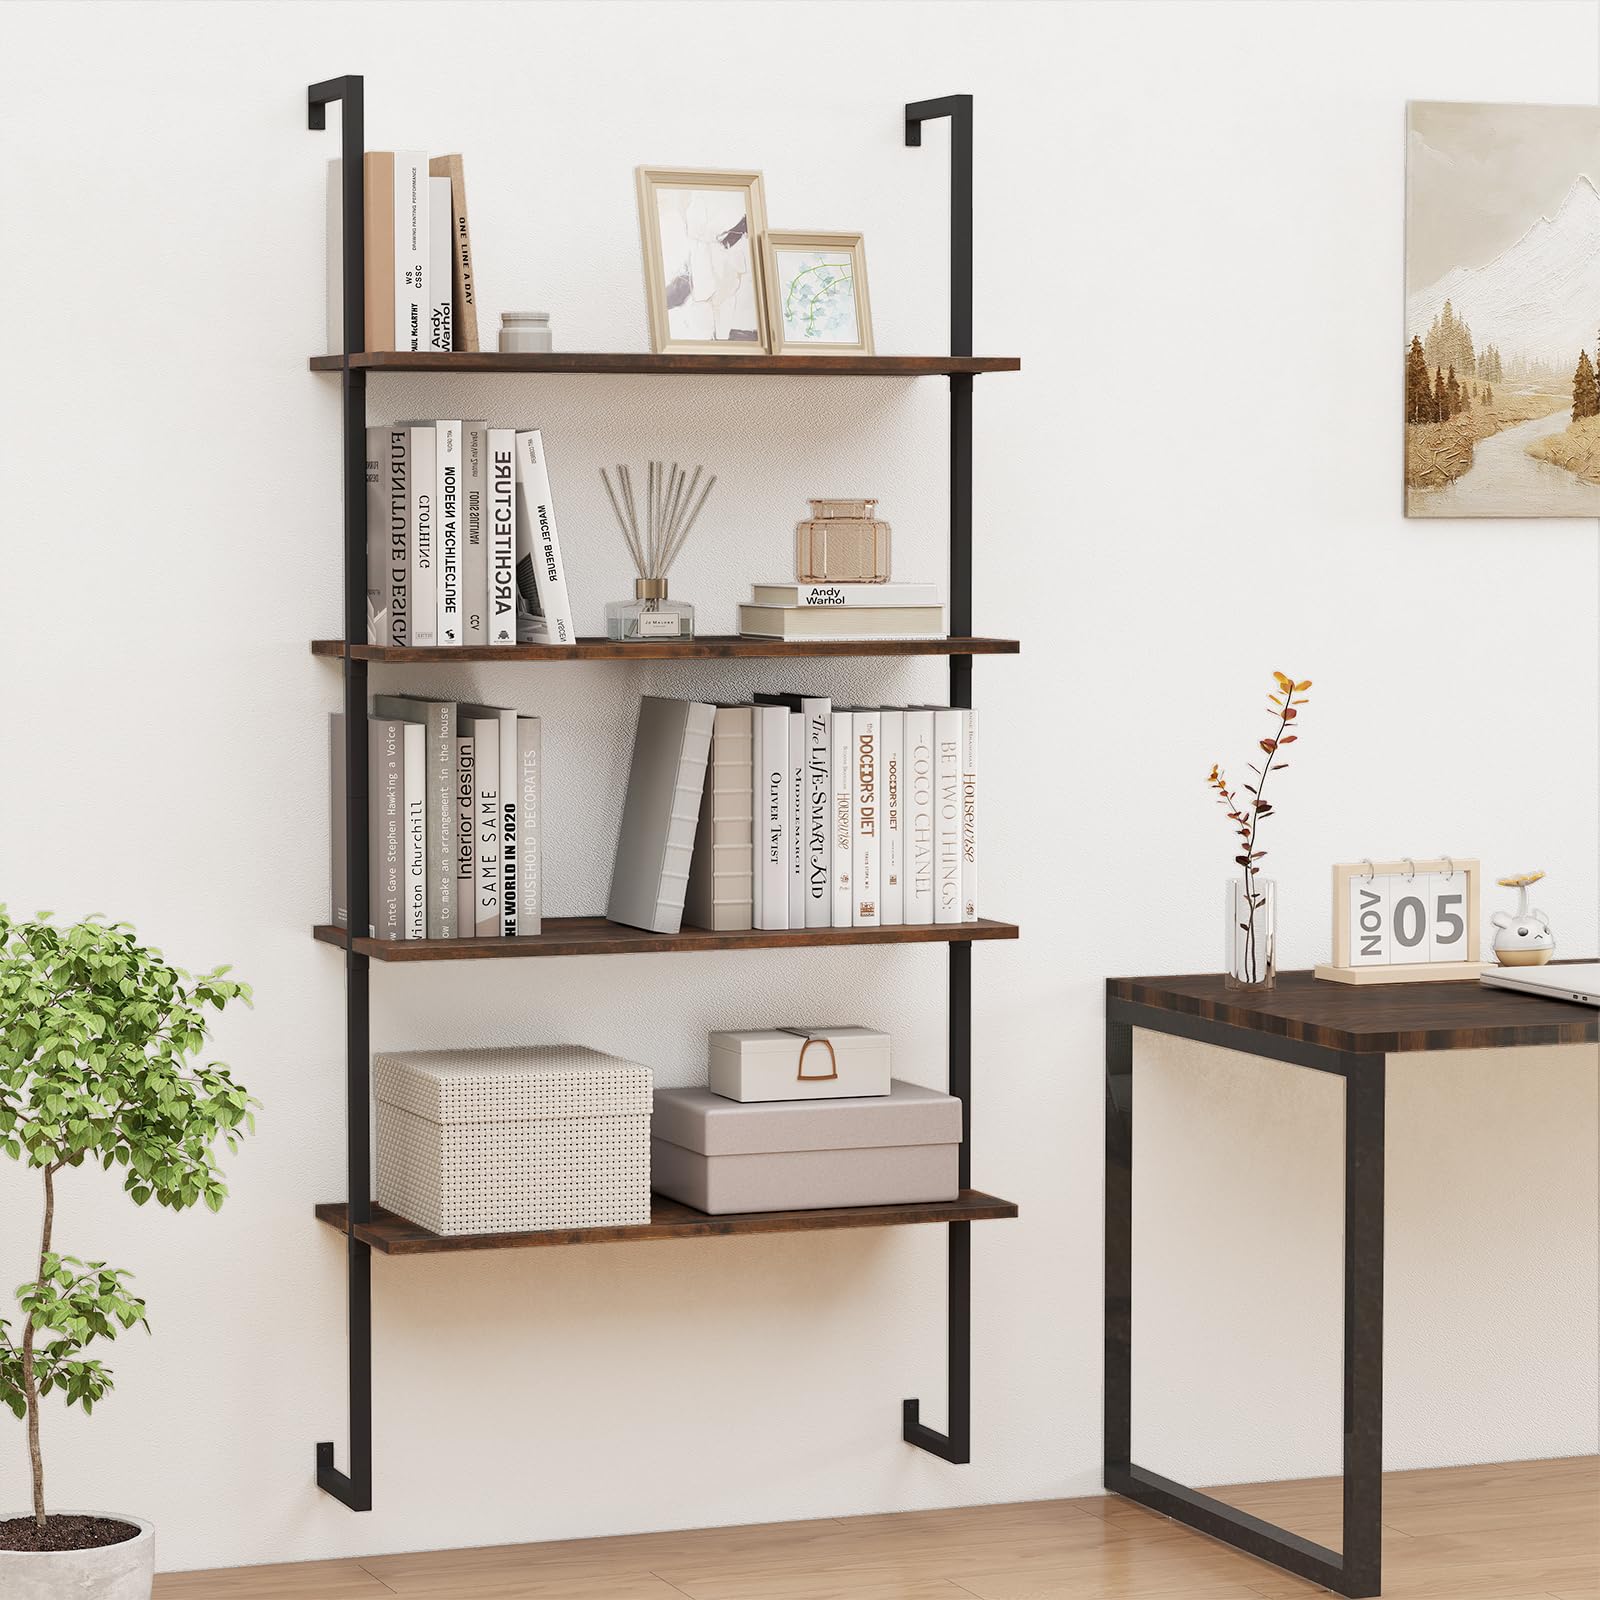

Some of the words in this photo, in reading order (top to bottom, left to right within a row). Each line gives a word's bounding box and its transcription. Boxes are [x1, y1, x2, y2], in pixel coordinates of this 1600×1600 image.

[459, 217, 467, 239] ONE
[461, 244, 470, 267] LINE
[406, 271, 413, 285] WS
[415, 264, 423, 289] CSSC
[465, 285, 473, 305] DAY
[431, 308, 443, 348] Andy
[440, 302, 450, 352] Warhol
[806, 596, 845, 605] Warhol
[811, 587, 841, 598] Andy
[439, 707, 449, 738] house
[812, 714, 827, 744] The
[386, 725, 396, 757] Voice
[439, 743, 449, 762] the
[941, 741, 957, 764] BE
[440, 768, 449, 781] in
[457, 744, 475, 808] design
[524, 749, 537, 828] DECORATES
[387, 772, 399, 815] Hawking
[770, 772, 782, 821] OLIVER
[941, 769, 957, 820] TWO
[440, 786, 451, 853] arrangement
[481, 790, 497, 842] SAME
[503, 803, 516, 843] 2020
[861, 806, 875, 837] DIET
[889, 810, 898, 831] DIET
[387, 819, 399, 862] Stephen
[410, 800, 423, 876] Churchill
[457, 814, 473, 880] Interior
[504, 845, 516, 862] IN
[770, 824, 782, 865] TWIST
[442, 859, 450, 872] an
[914, 813, 931, 899] CHANEL
[941, 830, 959, 910] THINGS:
[387, 868, 397, 892] Gave
[441, 877, 450, 903] make
[482, 855, 497, 907] SAME
[504, 865, 516, 916] WORLD
[524, 836, 537, 918] HOUSEHOLD
[387, 899, 397, 927] Intel
[441, 908, 450, 920] to
[1359, 889, 1383, 957] NOV
[442, 924, 450, 939] ow
